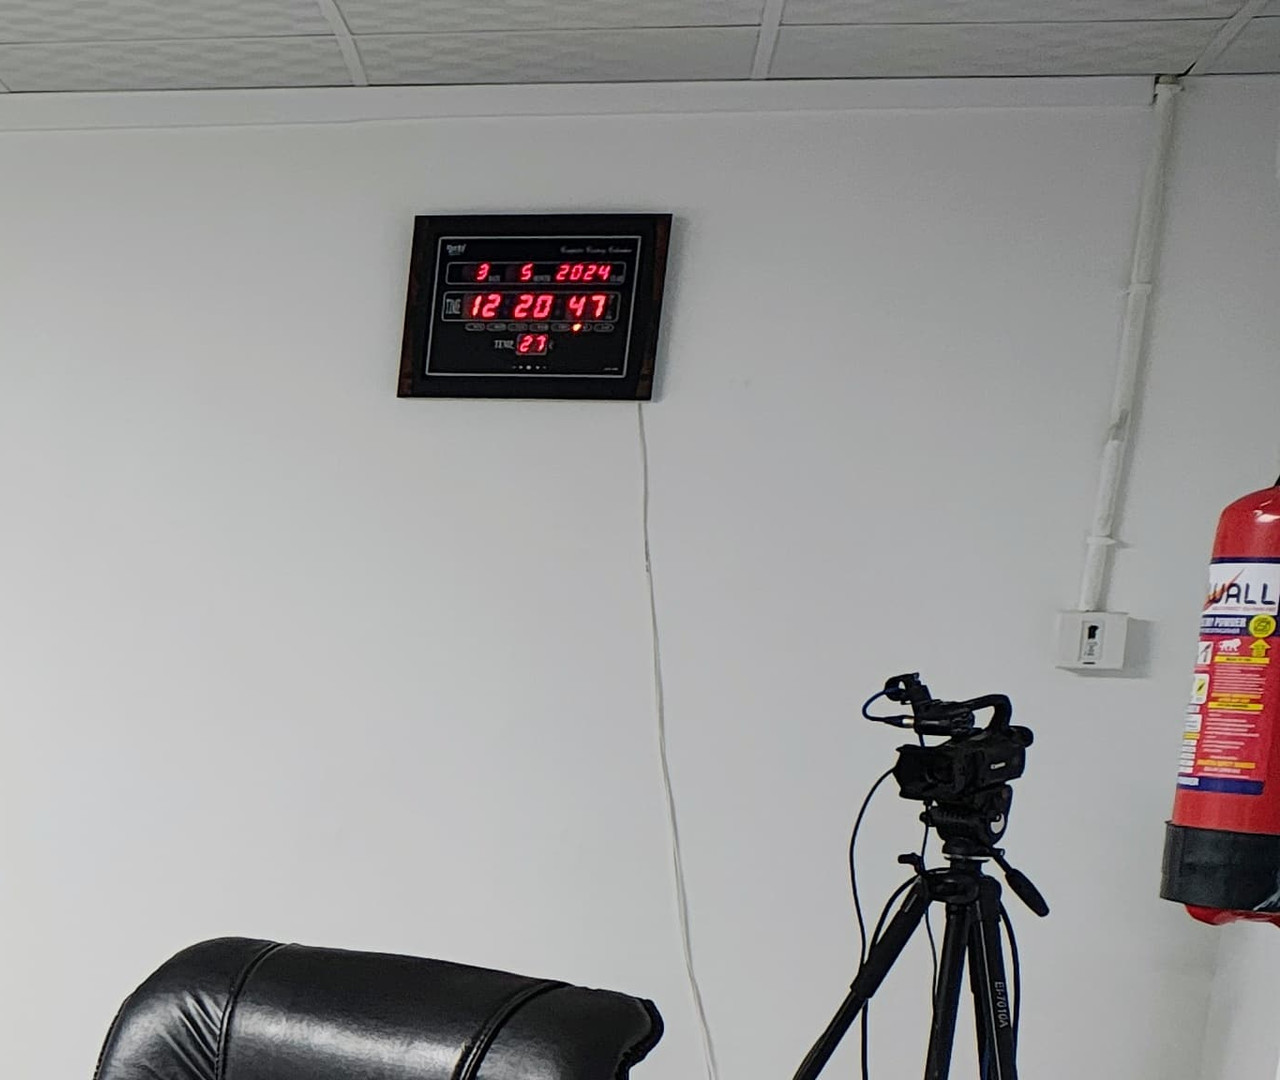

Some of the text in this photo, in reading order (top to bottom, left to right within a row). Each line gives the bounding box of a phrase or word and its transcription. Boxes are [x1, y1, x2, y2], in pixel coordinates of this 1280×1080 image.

[476, 262, 490, 281] 3
[520, 262, 534, 281] 5
[555, 262, 611, 281] 2024
[471, 294, 607, 318] 12 20 47
[520, 335, 547, 353] 27
